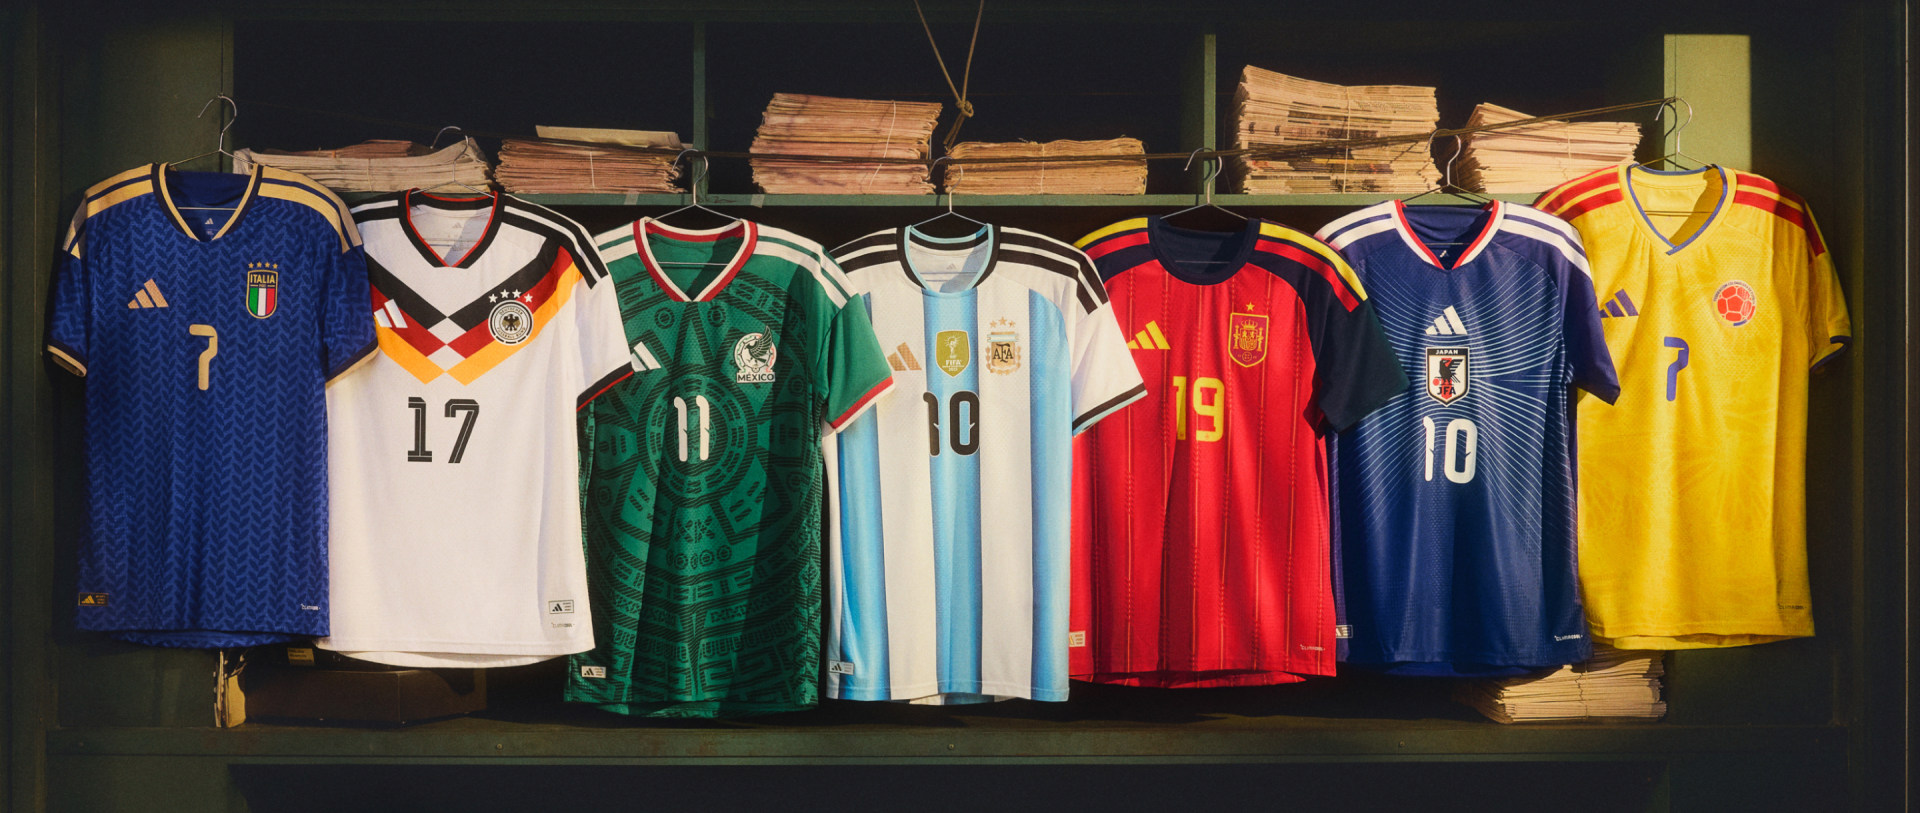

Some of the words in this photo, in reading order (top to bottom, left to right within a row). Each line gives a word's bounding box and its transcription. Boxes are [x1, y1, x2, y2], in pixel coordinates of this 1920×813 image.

[250, 274, 275, 284] ITALIA
[189, 324, 218, 391] 7
[992, 343, 1014, 363] AFA
[1664, 336, 1689, 401] 7
[923, 390, 980, 457] 10
[1173, 375, 1225, 443] 19
[1437, 386, 1456, 395] JFA
[407, 396, 480, 464] 17
[673, 395, 710, 462] 11
[1423, 415, 1478, 485] 10
